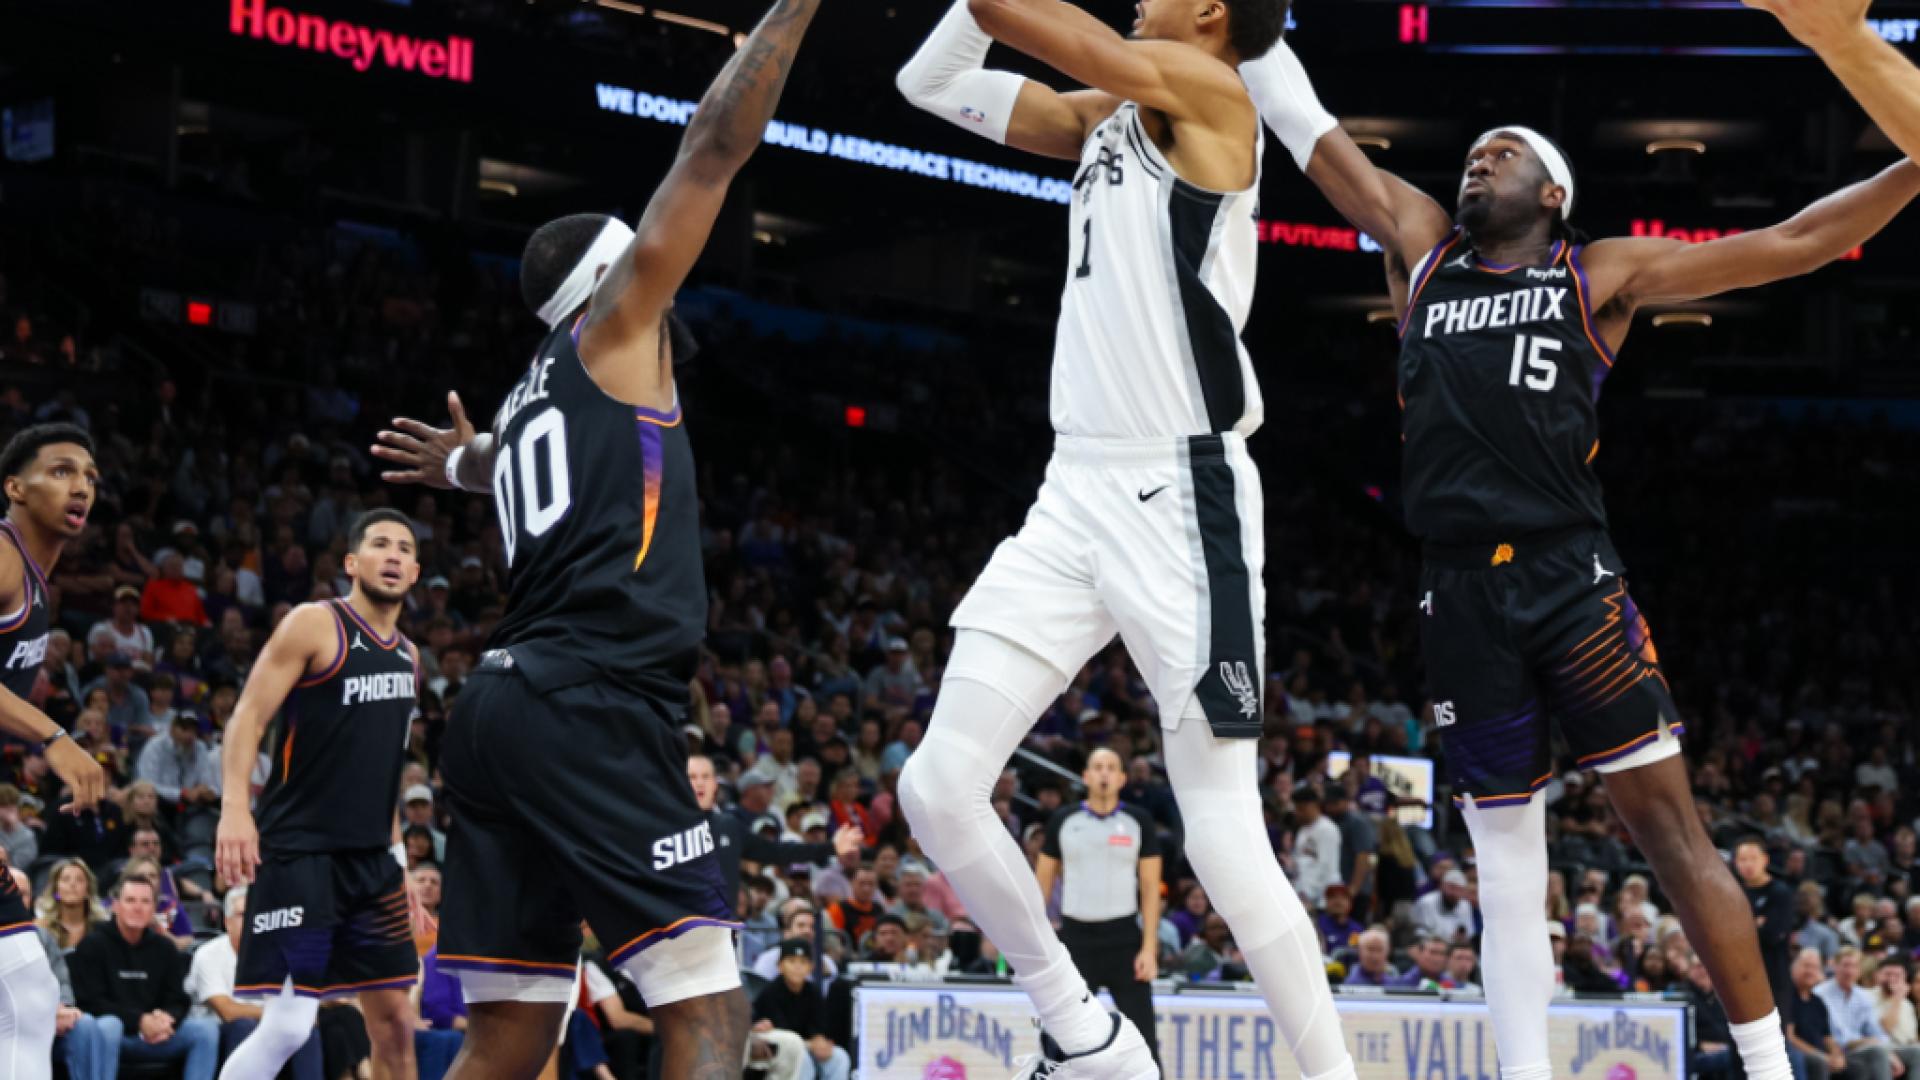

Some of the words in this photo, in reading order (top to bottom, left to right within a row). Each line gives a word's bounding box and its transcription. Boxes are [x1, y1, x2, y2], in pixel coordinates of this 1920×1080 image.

[229, 0, 473, 82] Honeywell
[596, 83, 634, 114] WE
[829, 132, 949, 180] AEROSPACE
[951, 158, 1073, 205] TECHNOLOG
[1076, 218, 1090, 278] 1
[1272, 222, 1357, 251] FUTURE
[1526, 268, 1567, 281] PayPal
[1424, 287, 1568, 339] PHOENIX
[1509, 334, 1562, 392] 15
[494, 406, 571, 569] 00
[253, 906, 304, 934] SUNS
[876, 1008, 930, 1069] JIM
[937, 994, 1012, 1071] BEAM
[1155, 1013, 1275, 1080] THER
[1356, 1032, 1390, 1063] THE
[1402, 1018, 1502, 1080] VALL
[1570, 1023, 1609, 1074] JIM
[1614, 1009, 1669, 1073] BEAM
